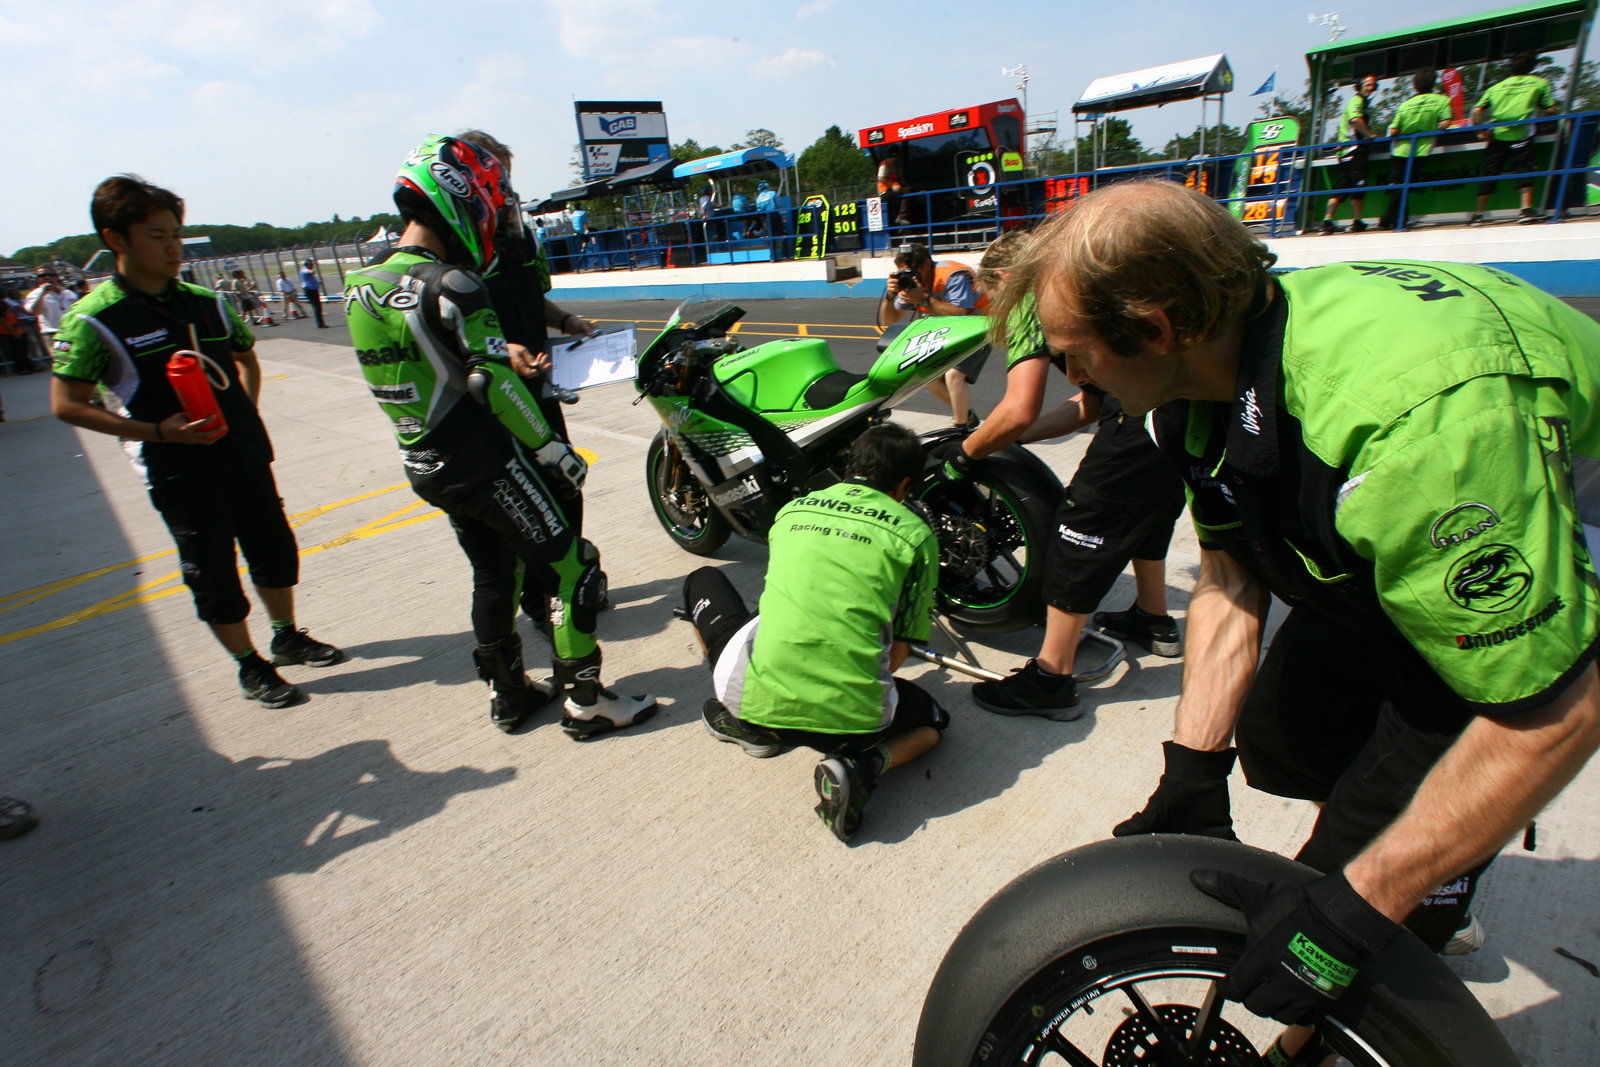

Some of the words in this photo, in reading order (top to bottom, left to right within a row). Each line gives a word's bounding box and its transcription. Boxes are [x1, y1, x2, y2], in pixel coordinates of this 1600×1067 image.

[609, 119, 635, 132] GAS
[1258, 123, 1284, 140] 56
[1250, 168, 1277, 185] P5
[834, 203, 857, 217] 123
[834, 221, 857, 234] 501
[343, 283, 419, 319] ANO
[898, 327, 951, 373] 56
[500, 380, 548, 439] Kawasaki
[1240, 387, 1263, 435] Ninja
[505, 457, 565, 537] Kawasaki
[793, 497, 902, 527] Kawasaki
[790, 524, 832, 536] Racing
[835, 528, 872, 545] Team
[1059, 523, 1105, 545] Kawasaki
[1438, 516, 1496, 547] MAN
[1456, 594, 1566, 650] BRIDGESTONE
